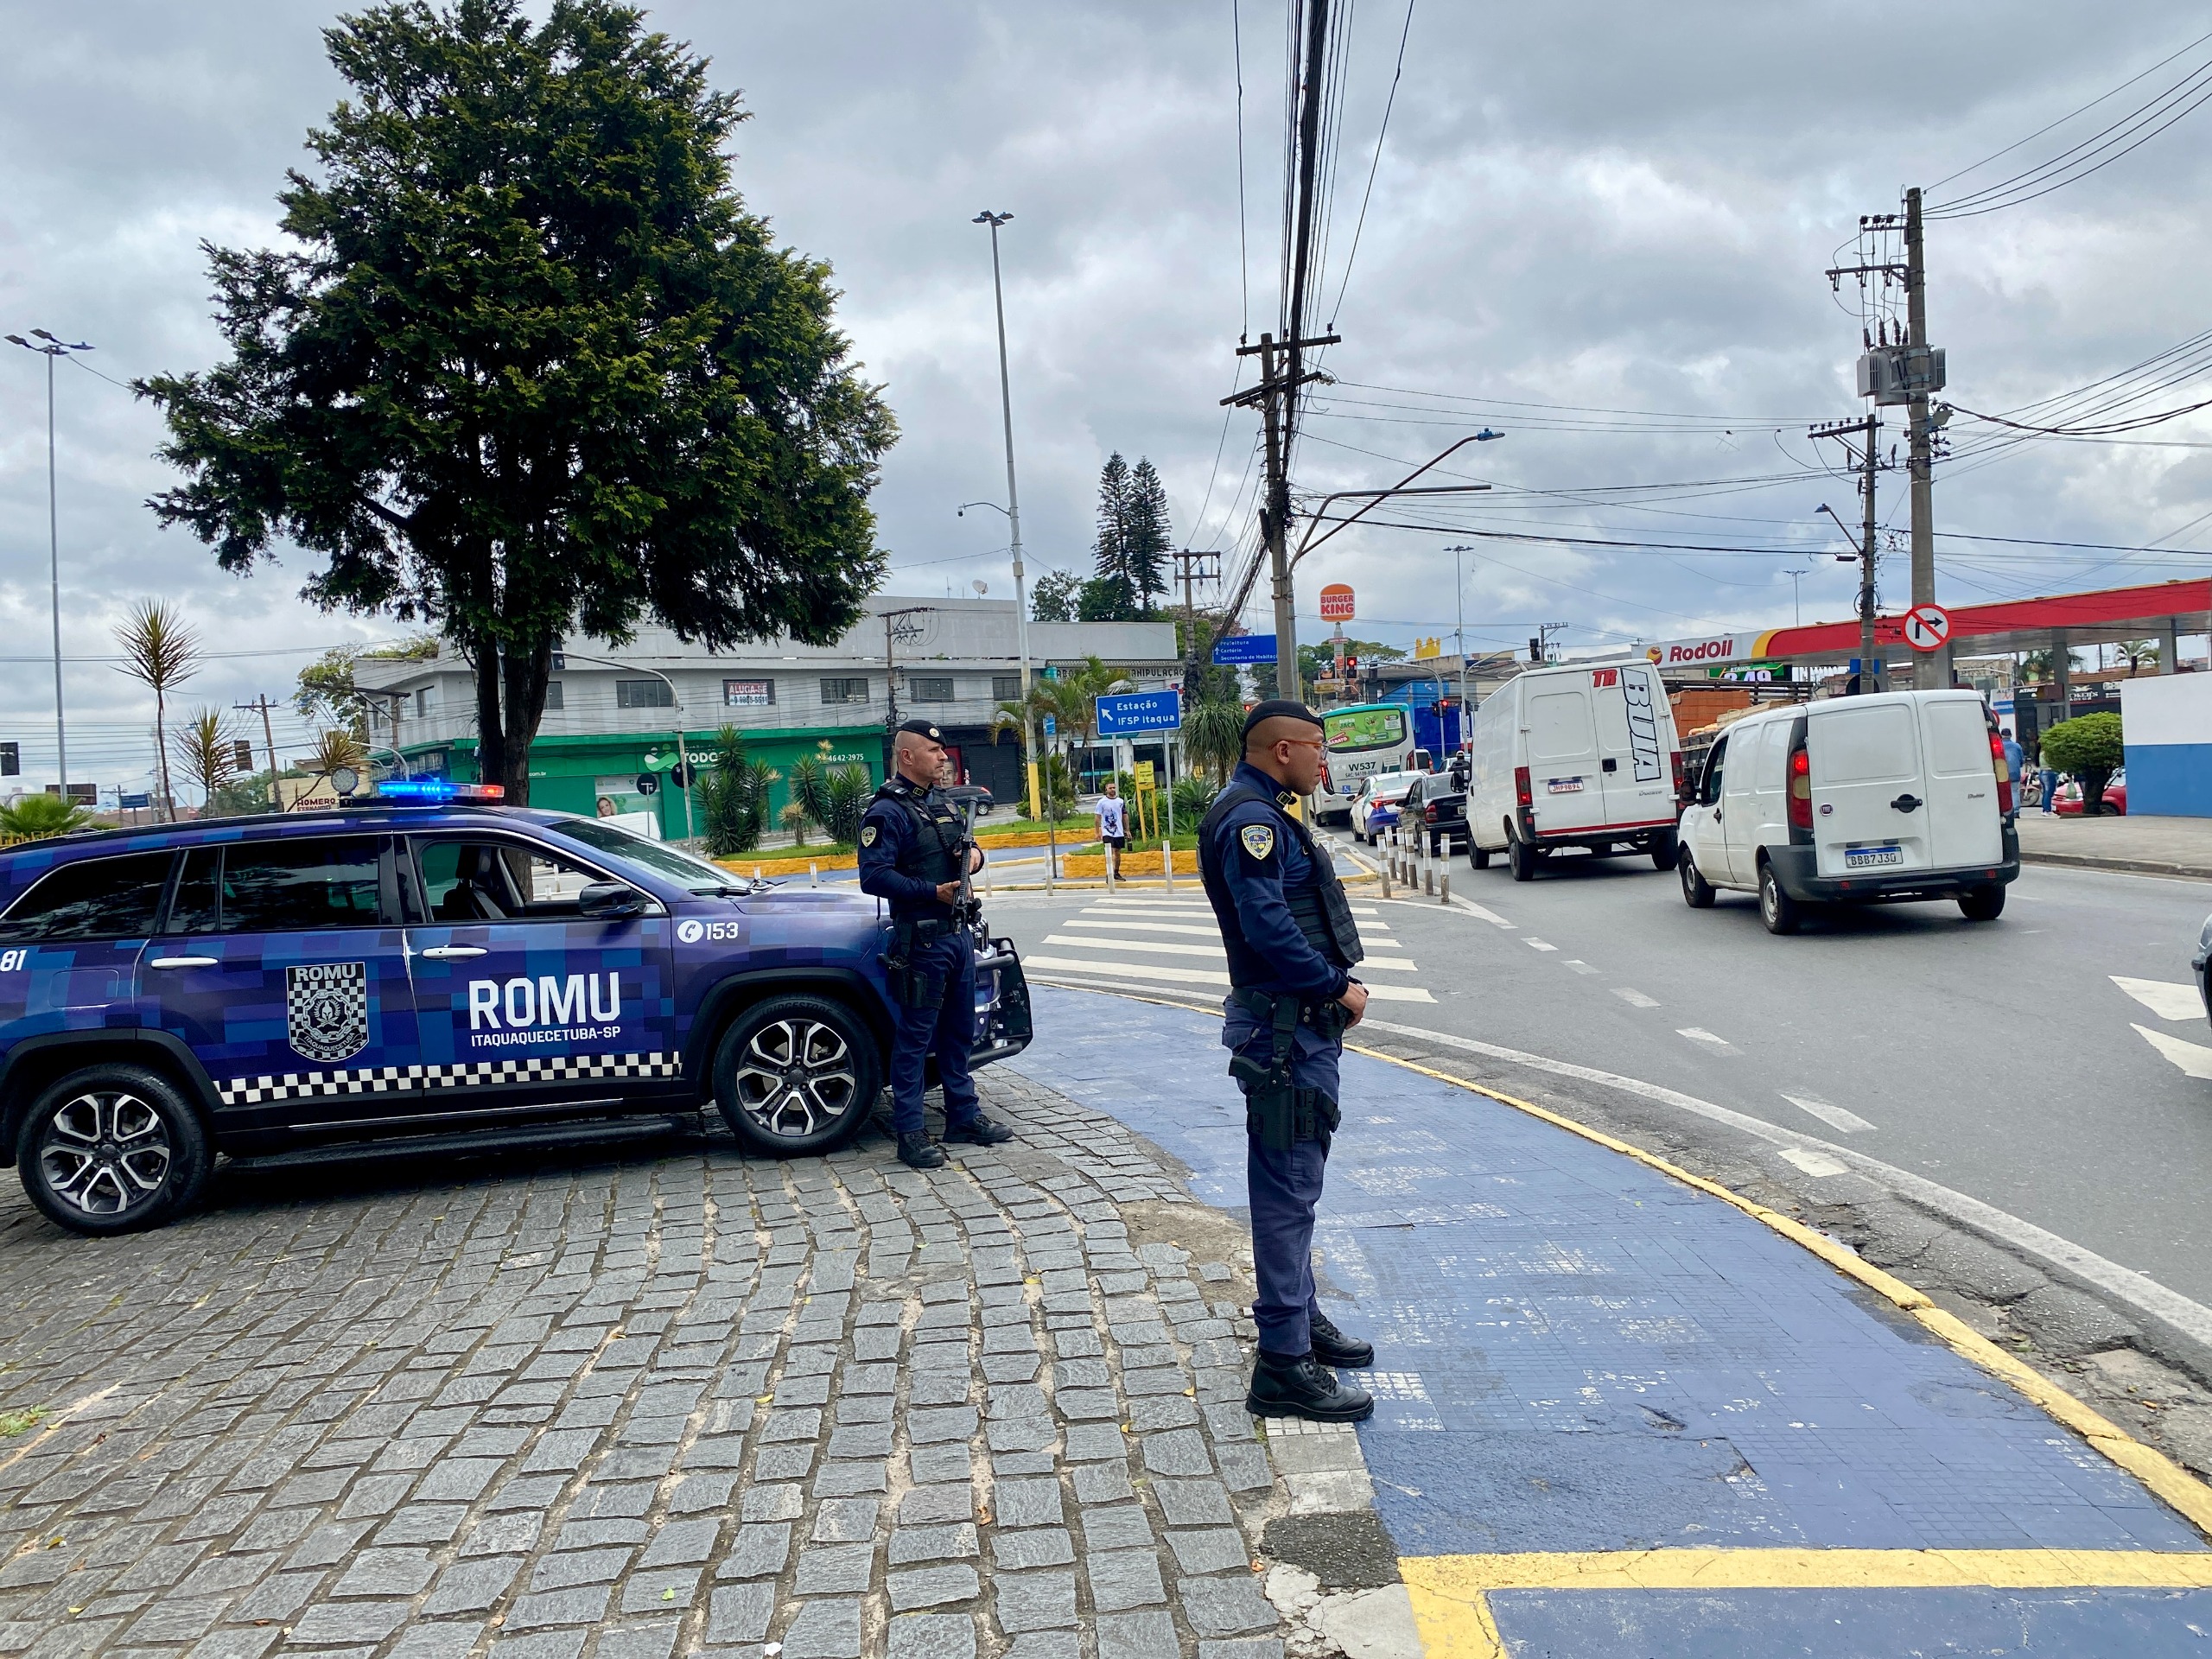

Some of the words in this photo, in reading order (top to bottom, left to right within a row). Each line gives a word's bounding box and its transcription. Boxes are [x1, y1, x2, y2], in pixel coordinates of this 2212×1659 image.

[1320, 594, 1354, 604] BURGER
[1321, 603, 1354, 614] KING
[1669, 639, 1733, 662] RodOil
[1129, 667, 1185, 677] ANIPULAÇÃO
[1592, 669, 1618, 688] TR
[728, 685, 767, 694] ALUGA-SE
[1116, 700, 1158, 711] Estação
[1117, 716, 1140, 726] IFSP
[1142, 715, 1175, 725] Itaqua
[1348, 761, 1376, 772] W537
[297, 798, 335, 807] HOMERO
[706, 922, 739, 941] 153
[295, 963, 356, 982] ROMU
[469, 972, 620, 1030] ROMU
[471, 1026, 621, 1047] ITAQUAQUECETUBA-SP
[304, 1033, 355, 1052] ITAQUAQUECETUBA
